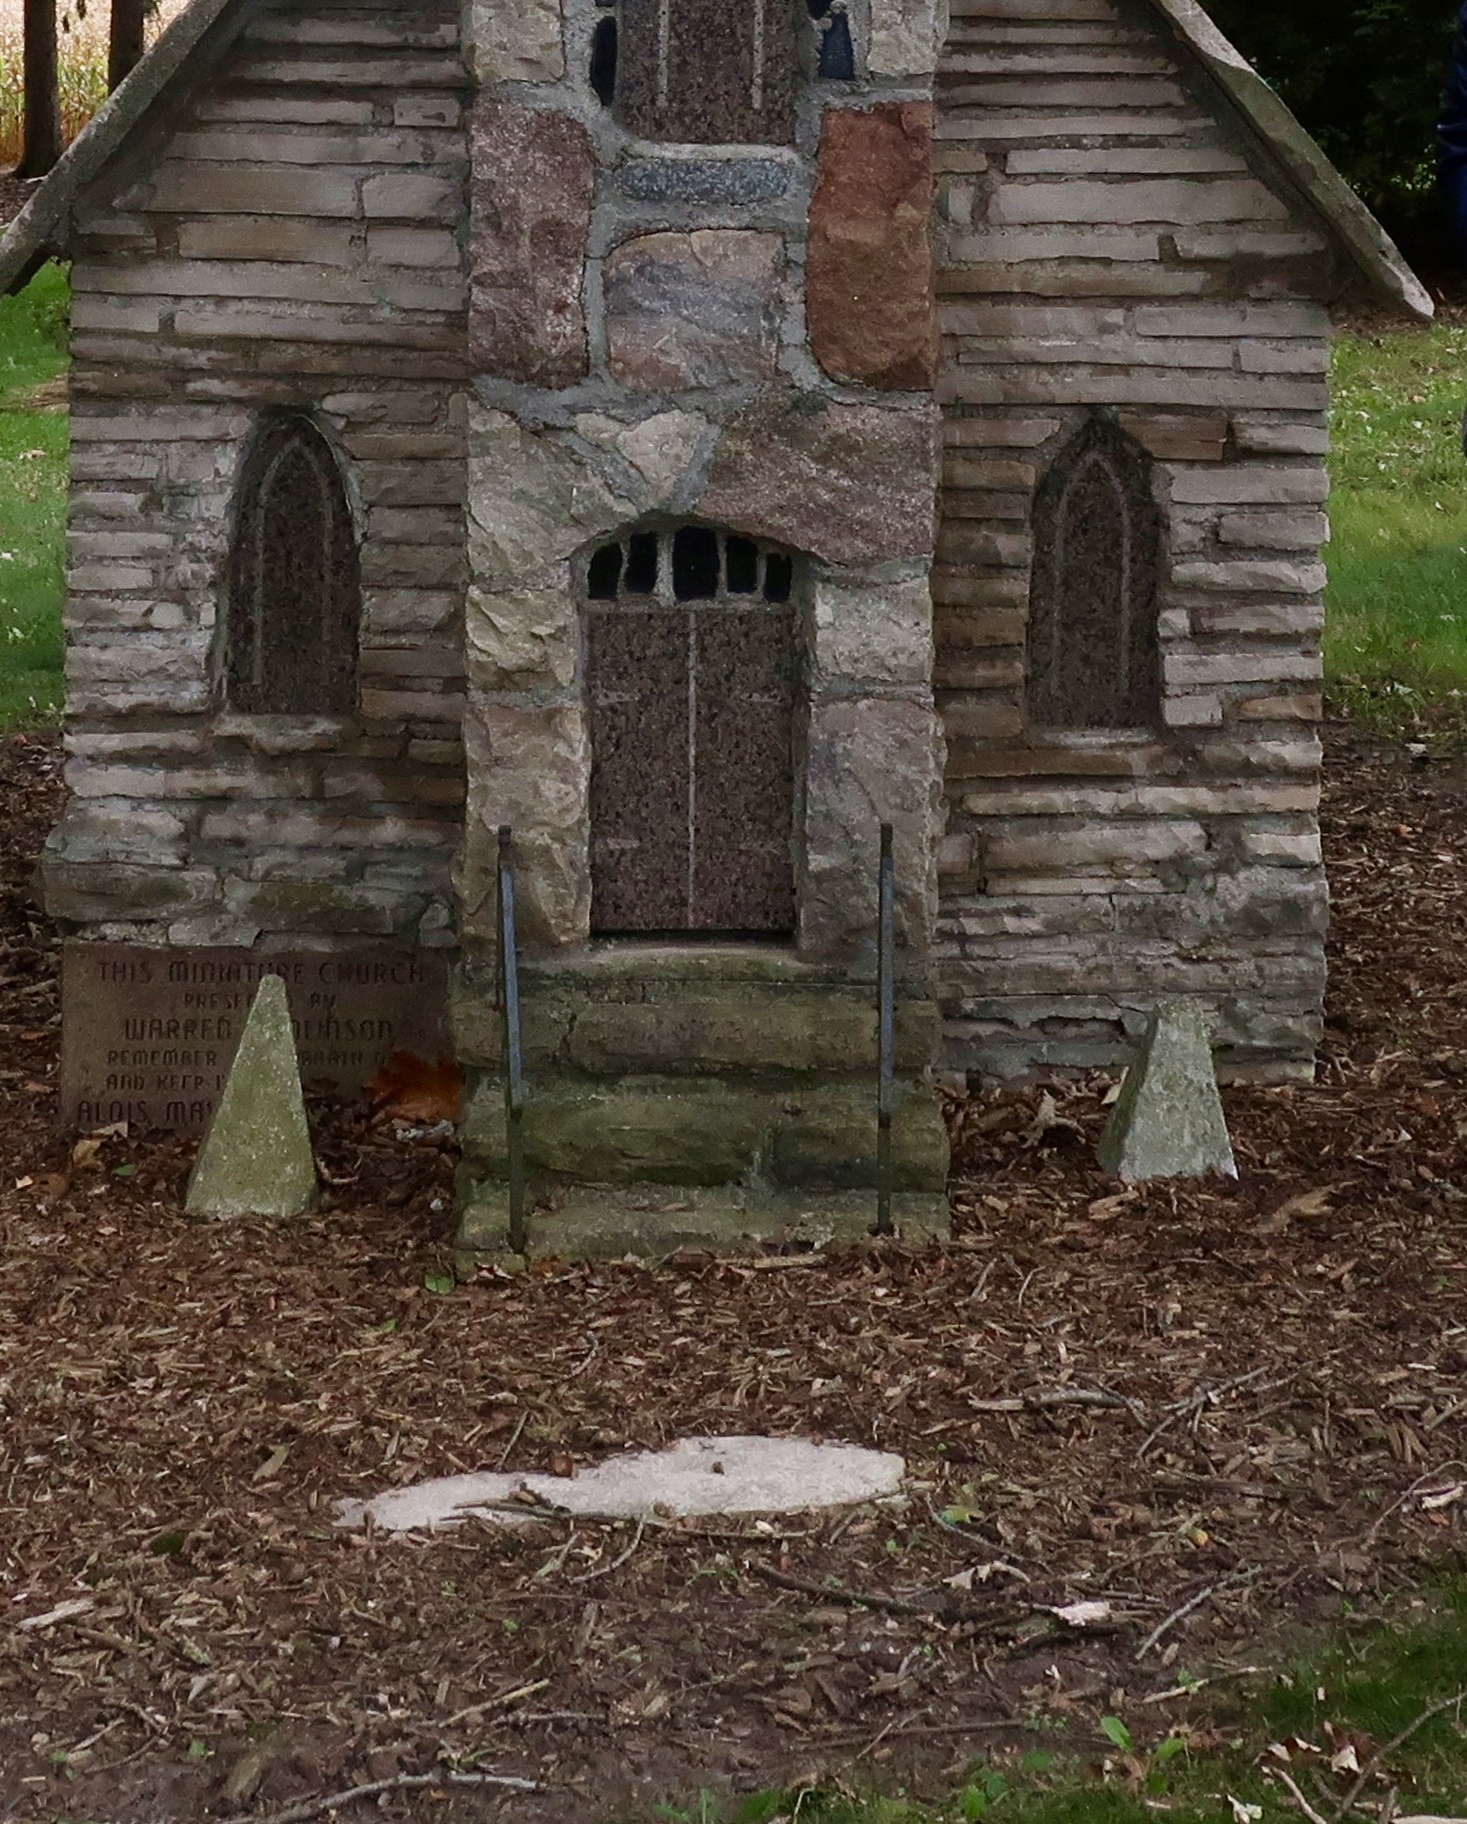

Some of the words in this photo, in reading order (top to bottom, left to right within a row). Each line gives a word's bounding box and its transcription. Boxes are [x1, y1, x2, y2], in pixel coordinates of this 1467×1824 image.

[98, 961, 152, 984] THIS
[319, 961, 425, 985] CHURCH
[125, 1016, 232, 1041] WARREN
[107, 1049, 217, 1067] REMEMBER
[106, 1074, 145, 1091] AND
[157, 1074, 204, 1091] KEEP
[77, 1100, 150, 1124] ALOIS
